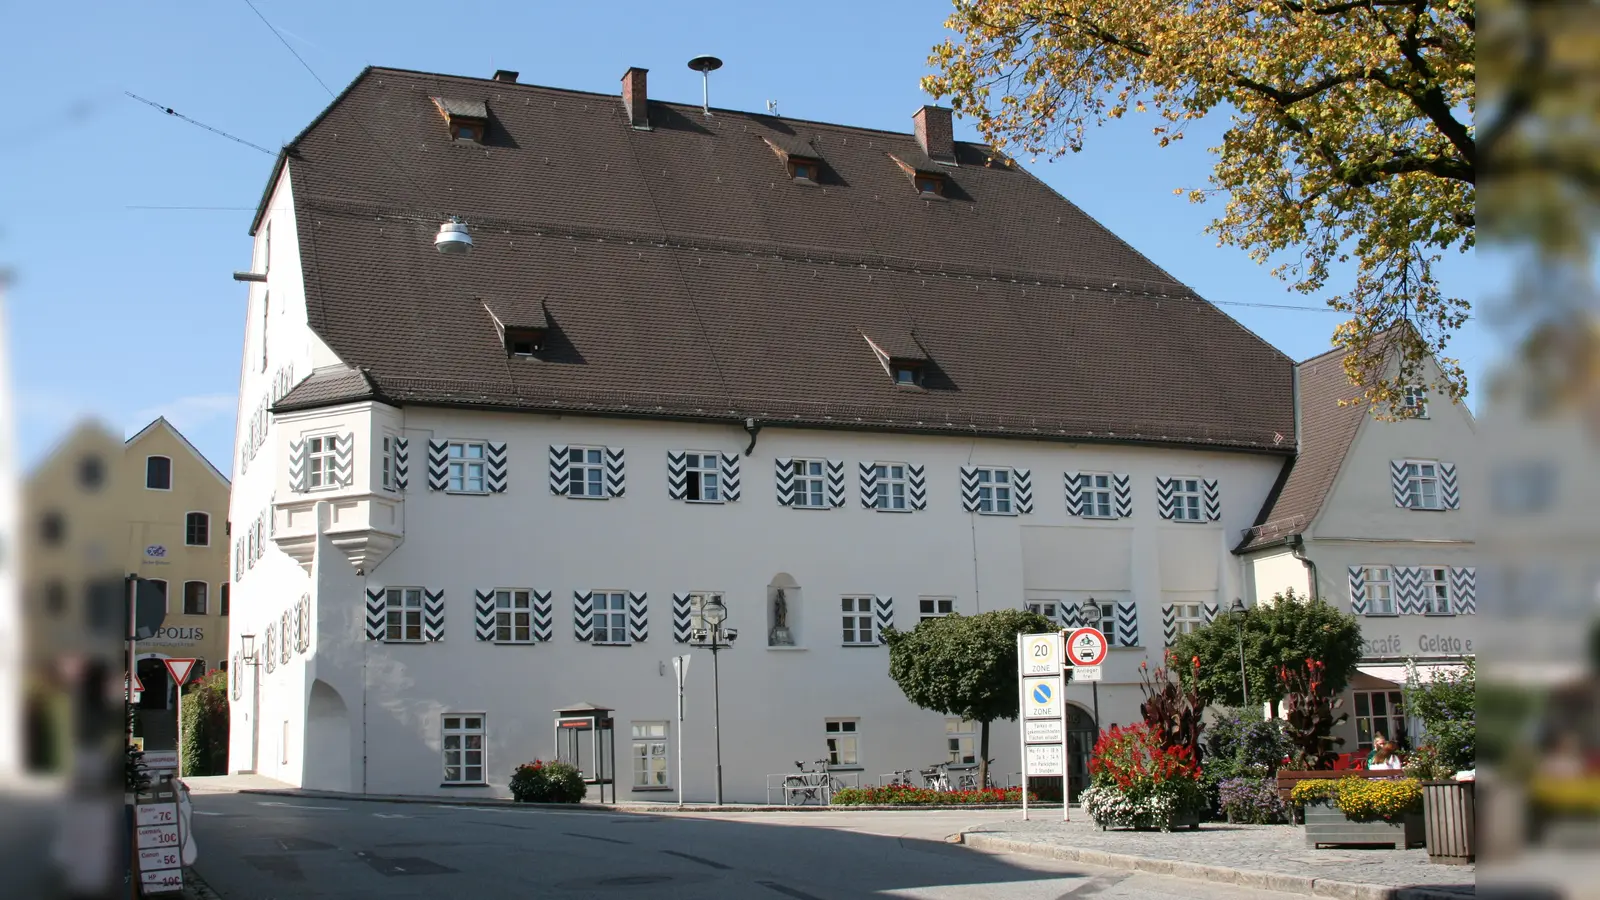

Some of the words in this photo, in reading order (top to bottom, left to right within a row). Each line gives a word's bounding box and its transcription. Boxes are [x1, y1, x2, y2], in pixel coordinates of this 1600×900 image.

[156, 627, 204, 641] POLIS
[1419, 634, 1461, 652] Gelato
[1465, 639, 1473, 651] e
[1034, 644, 1048, 657] 20
[1032, 664, 1051, 672] ZONE
[1033, 708, 1052, 716] ZONE
[158, 811, 172, 821] 7€
[158, 833, 177, 844] 10€
[163, 855, 176, 865] 5€
[162, 876, 181, 887] 10€
